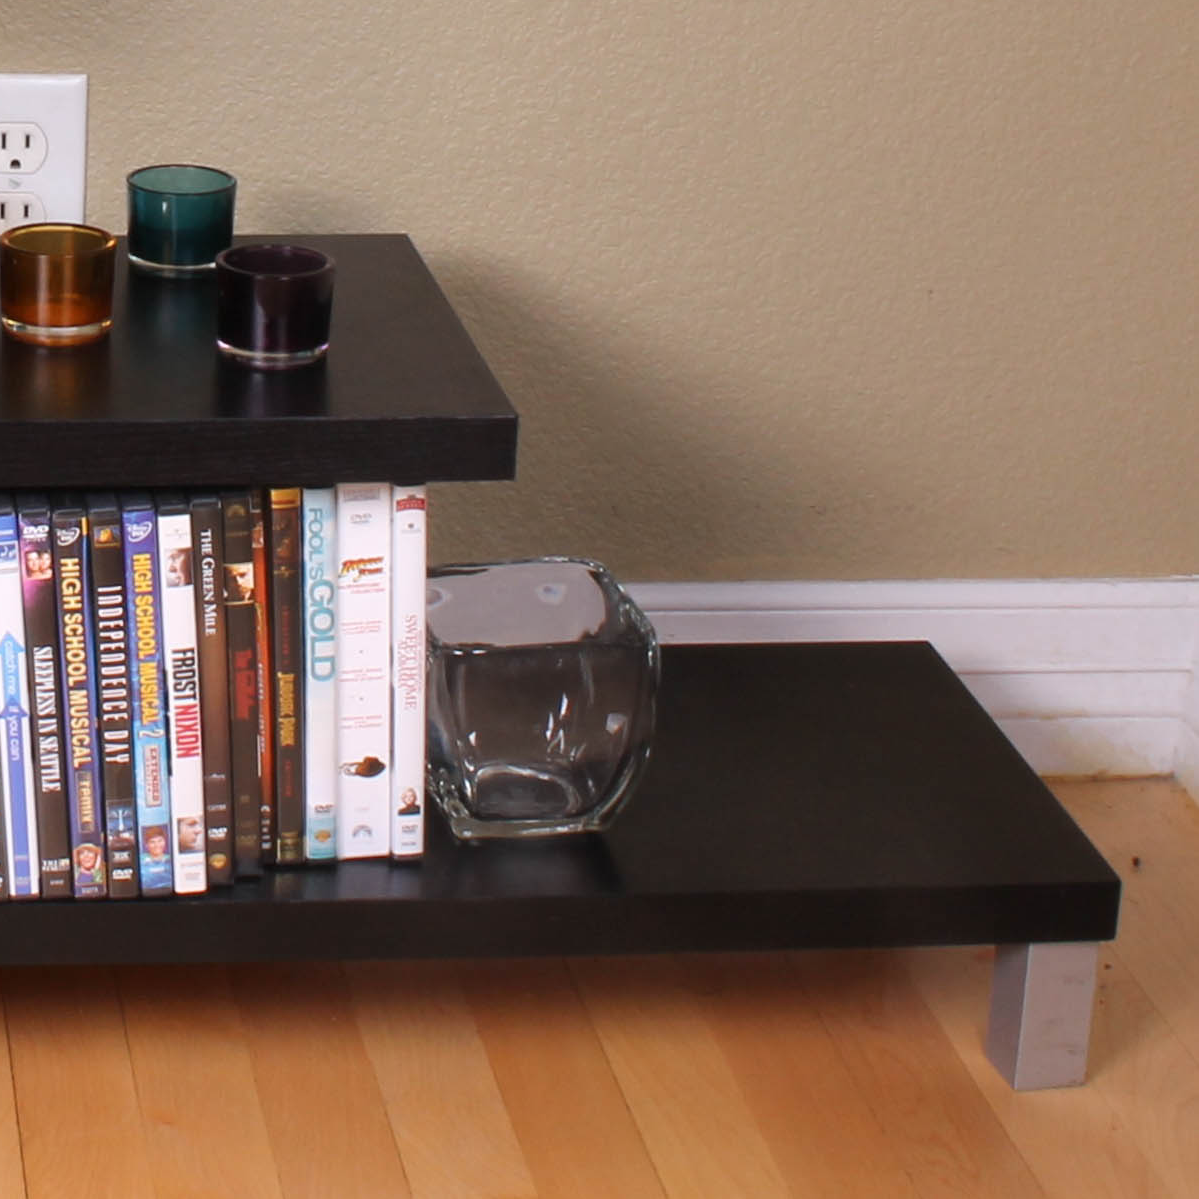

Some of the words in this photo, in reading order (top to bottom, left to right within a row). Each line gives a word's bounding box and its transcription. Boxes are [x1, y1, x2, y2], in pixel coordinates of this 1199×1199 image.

[23, 526, 49, 538] DVD
[200, 528, 213, 555] THE
[309, 507, 323, 579] FOOL'S
[60, 558, 82, 609] HIGH
[133, 554, 153, 593] HIGH
[200, 557, 216, 602] GREEN
[135, 595, 155, 658] SCHOOL
[203, 603, 217, 635] MILE
[309, 579, 336, 682] GOLD
[64, 613, 87, 686] SCHOOL
[97, 586, 128, 721] INDEPENDENCE
[139, 662, 159, 725] MUSICAL
[172, 647, 197, 701] FROST
[9, 715, 19, 738] you
[38, 718, 57, 734] IN
[69, 690, 91, 768] MUSICAL
[104, 730, 130, 765] DAY
[138, 728, 163, 738] 2
[174, 703, 200, 759] NIXON
[11, 740, 20, 761] can
[78, 779, 92, 823] remix
